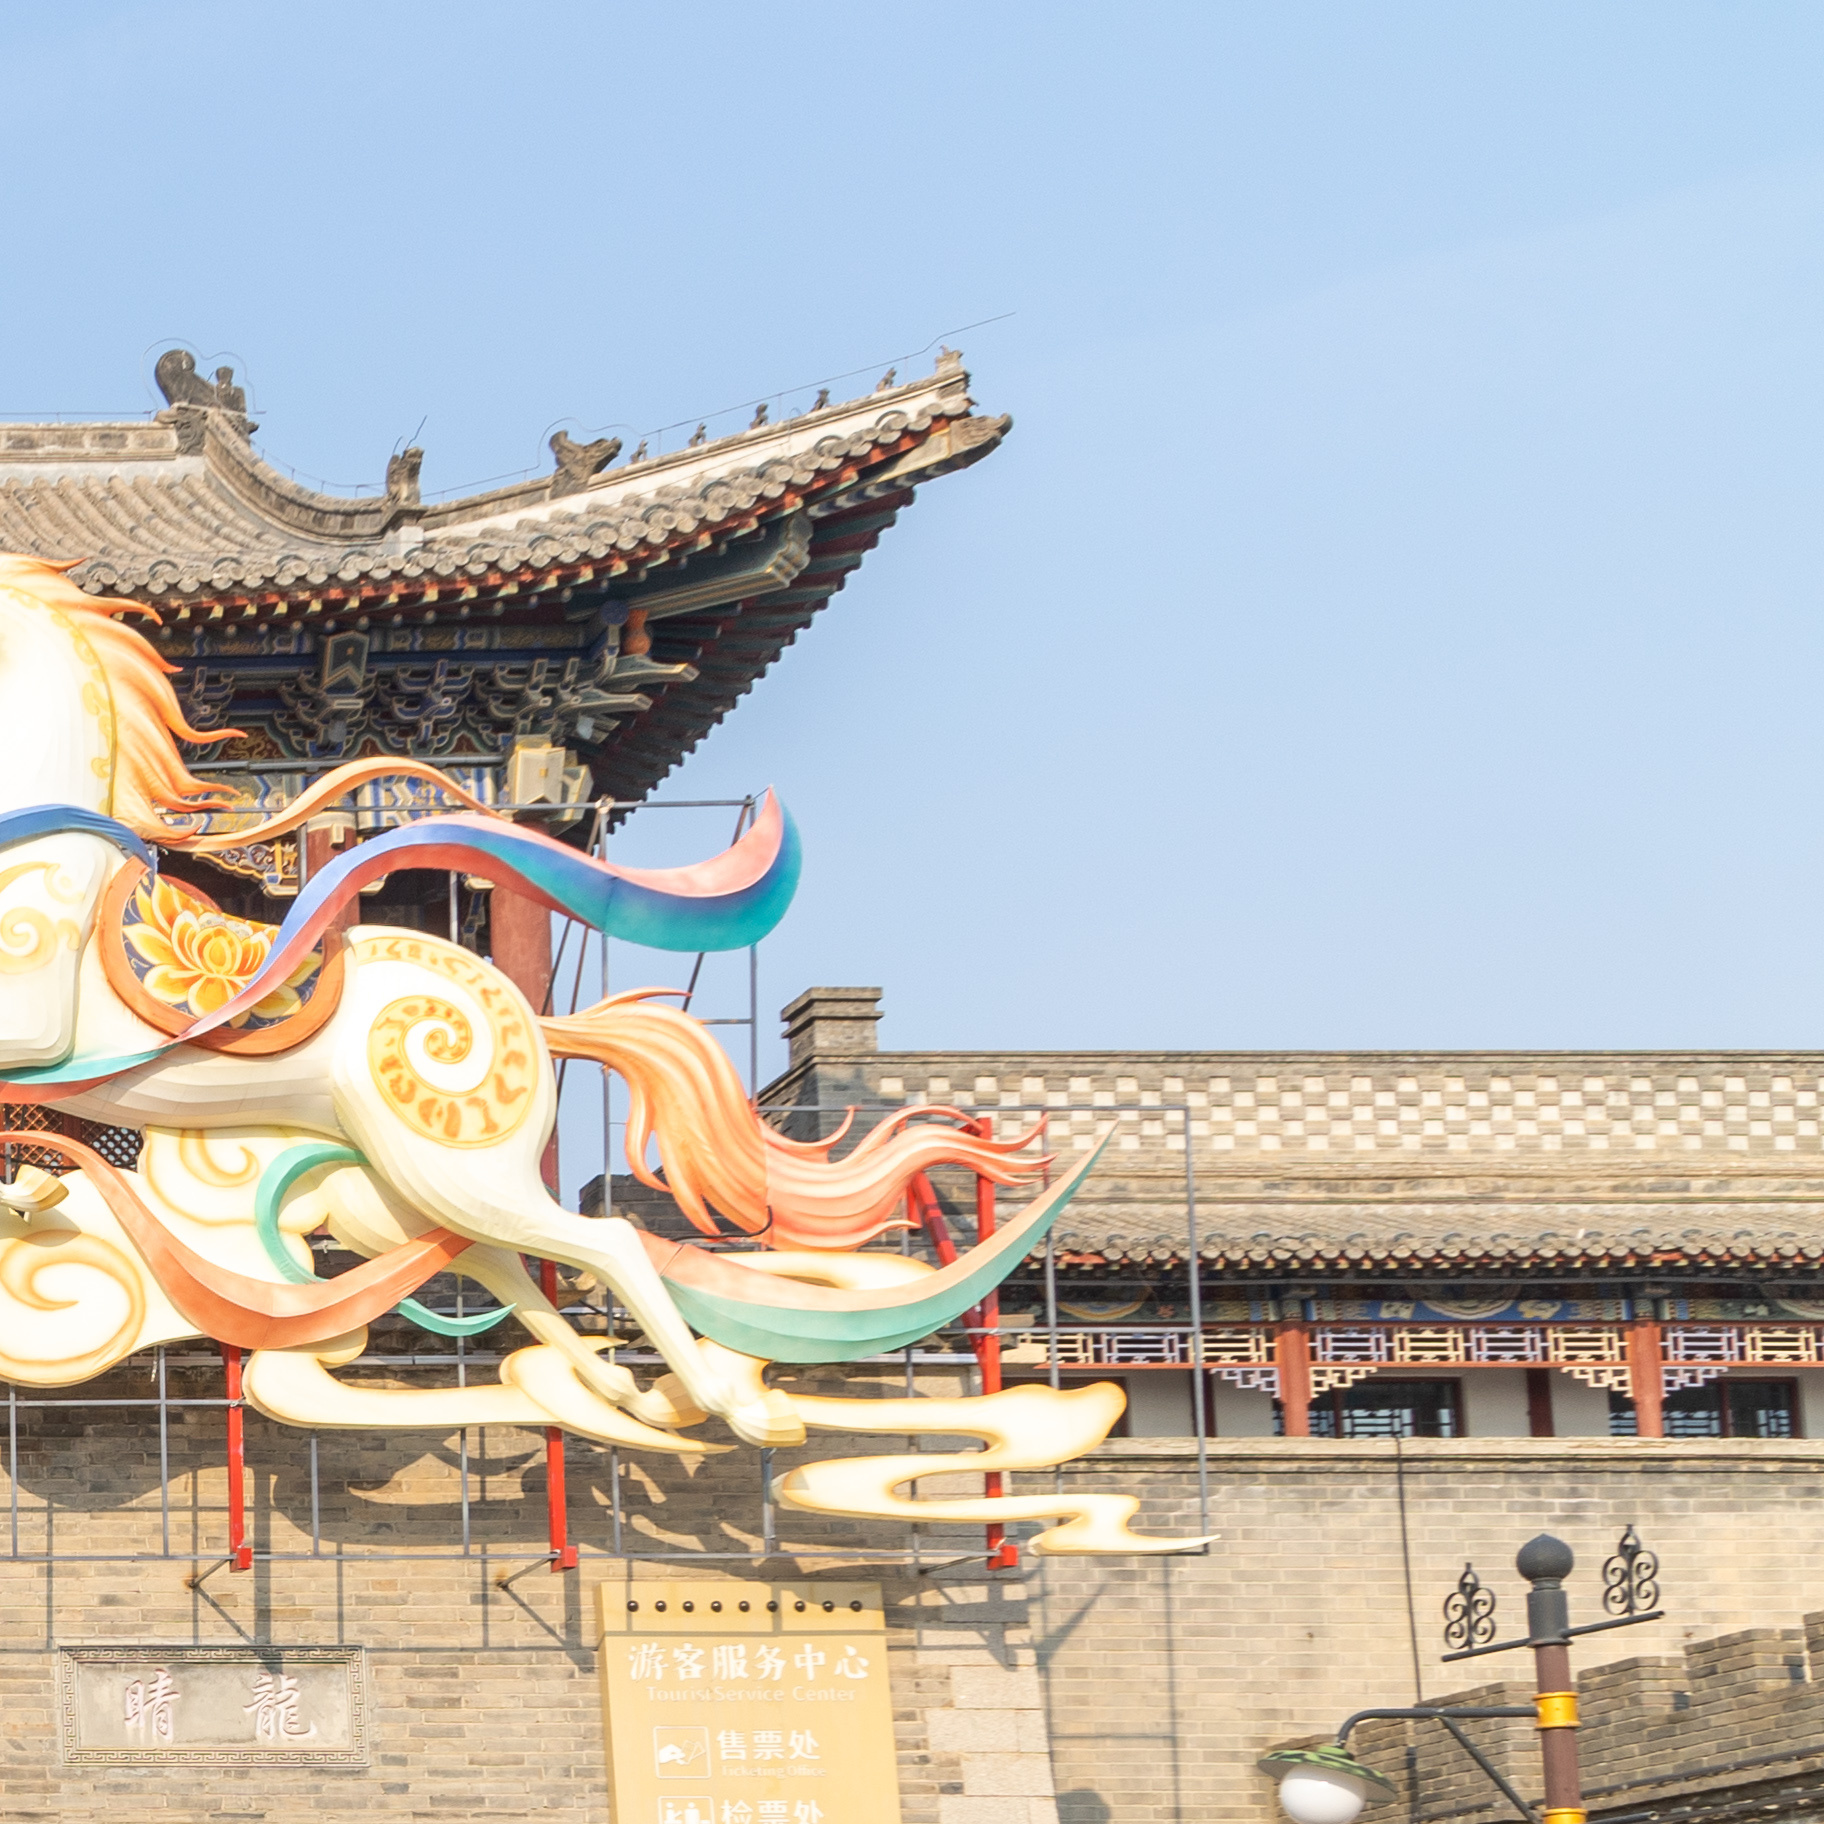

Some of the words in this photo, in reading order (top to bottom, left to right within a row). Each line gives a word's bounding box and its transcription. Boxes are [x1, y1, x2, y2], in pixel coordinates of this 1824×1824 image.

[628, 1643, 870, 1682] 游客服务中心
[713, 1686, 784, 1702] Service
[792, 1686, 856, 1702] Center
[716, 1730, 821, 1760] 售票处
